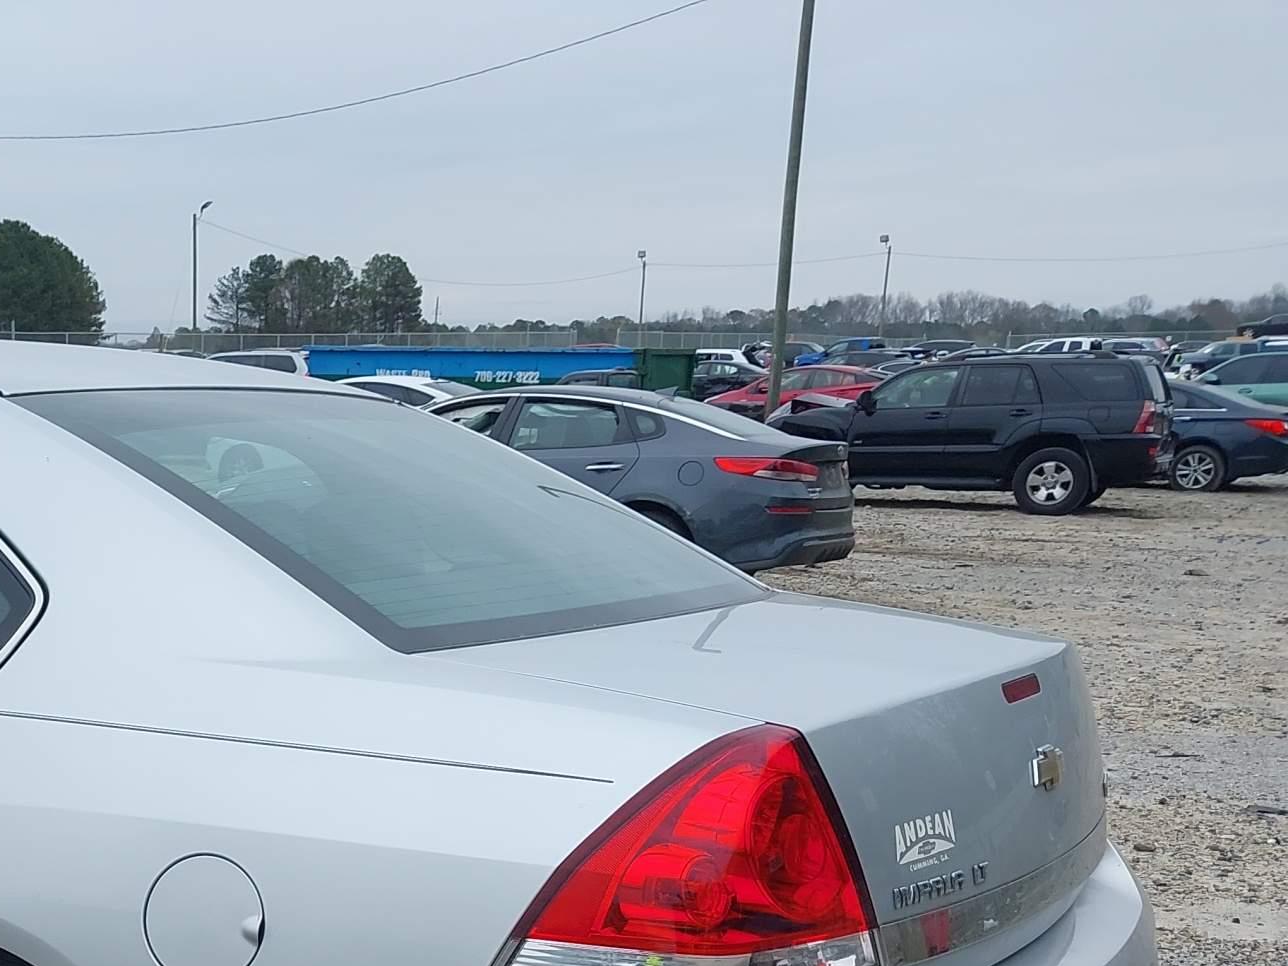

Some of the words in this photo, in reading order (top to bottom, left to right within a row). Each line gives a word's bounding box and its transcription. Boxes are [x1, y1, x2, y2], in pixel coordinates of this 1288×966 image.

[895, 808, 956, 863] ANDEAN
[892, 870, 966, 910] IMPALA
[971, 861, 989, 885] LT
